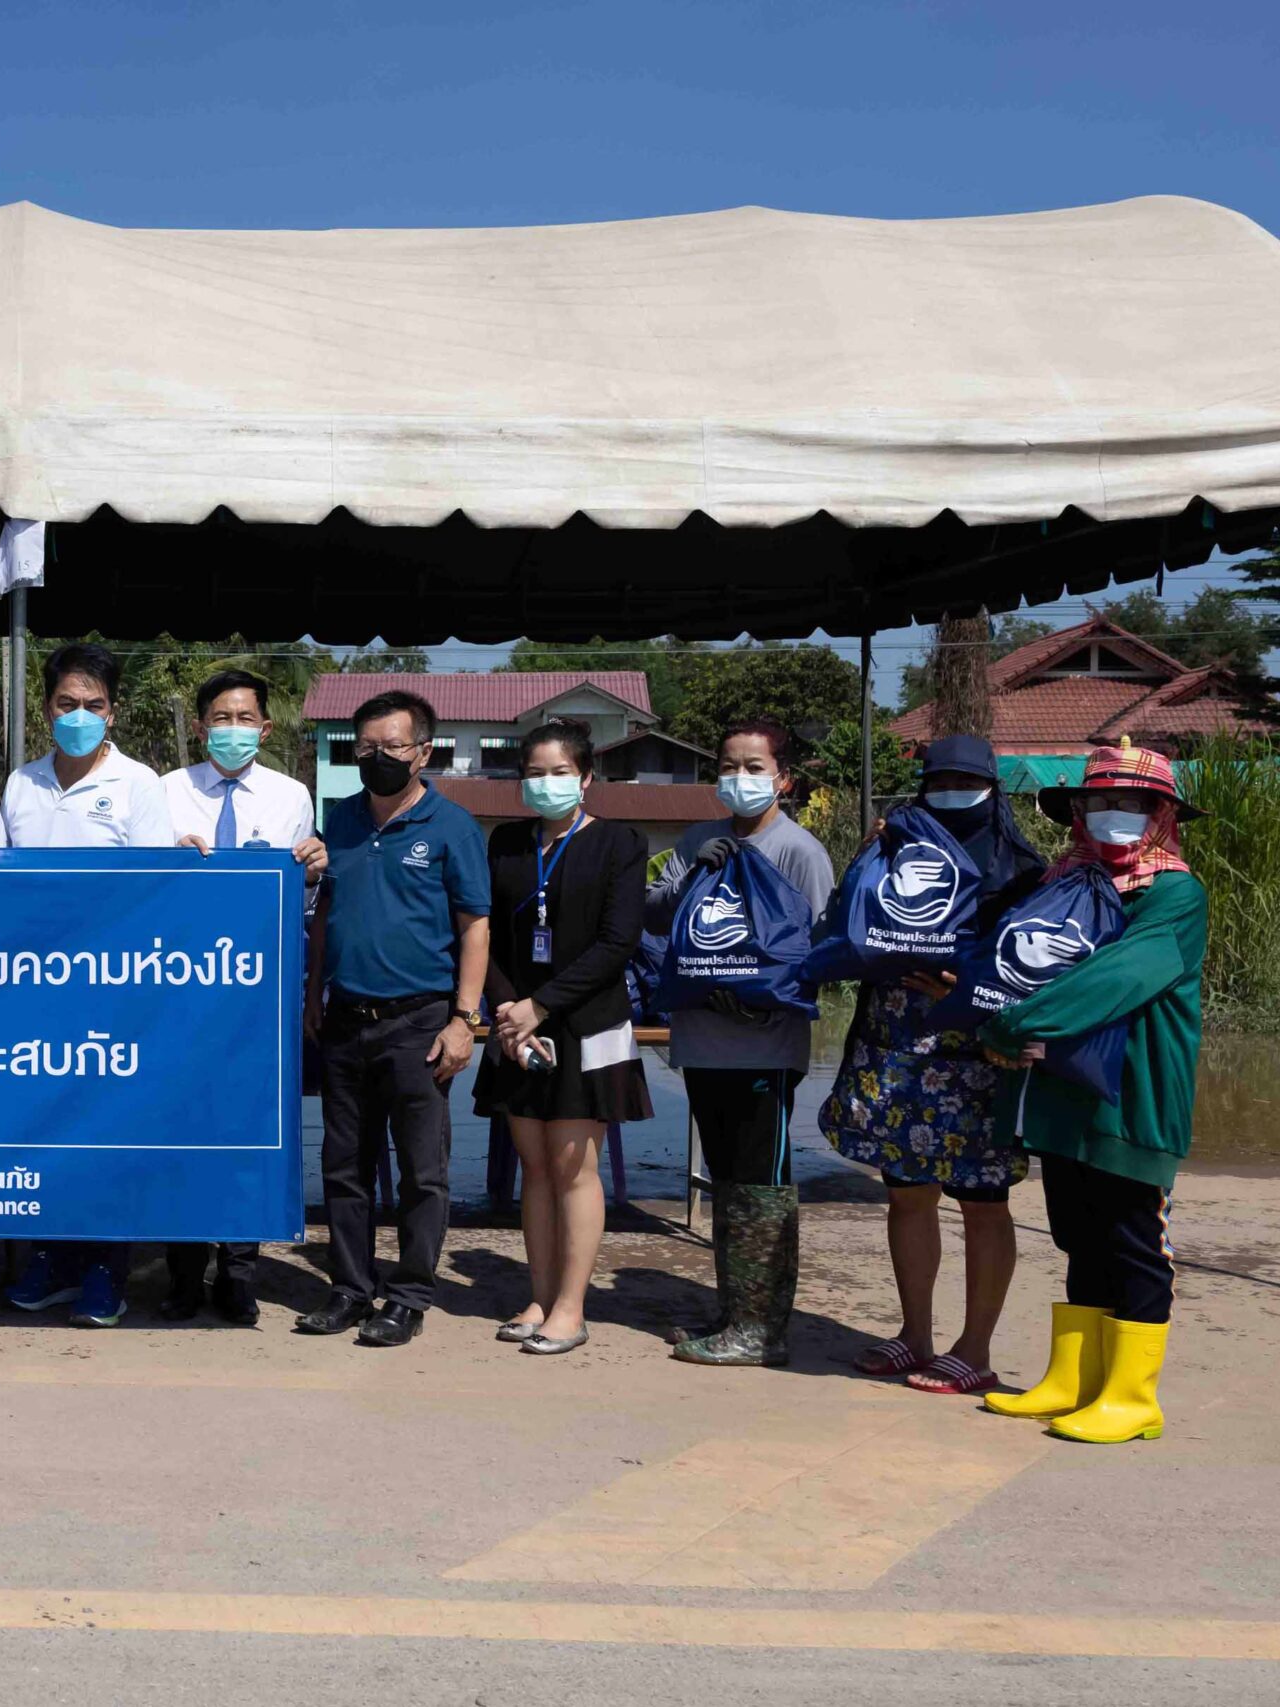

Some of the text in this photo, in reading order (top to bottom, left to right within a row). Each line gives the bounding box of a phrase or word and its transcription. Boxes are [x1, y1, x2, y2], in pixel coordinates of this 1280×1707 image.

[18, 560, 30, 571] 15
[868, 927, 956, 943] กรุงเทพประกันภัย
[865, 937, 955, 954] Bangkok Insurance
[678, 955, 758, 967] กรุงเทพประกันภัย
[677, 967, 759, 978] Bangkok Insurance
